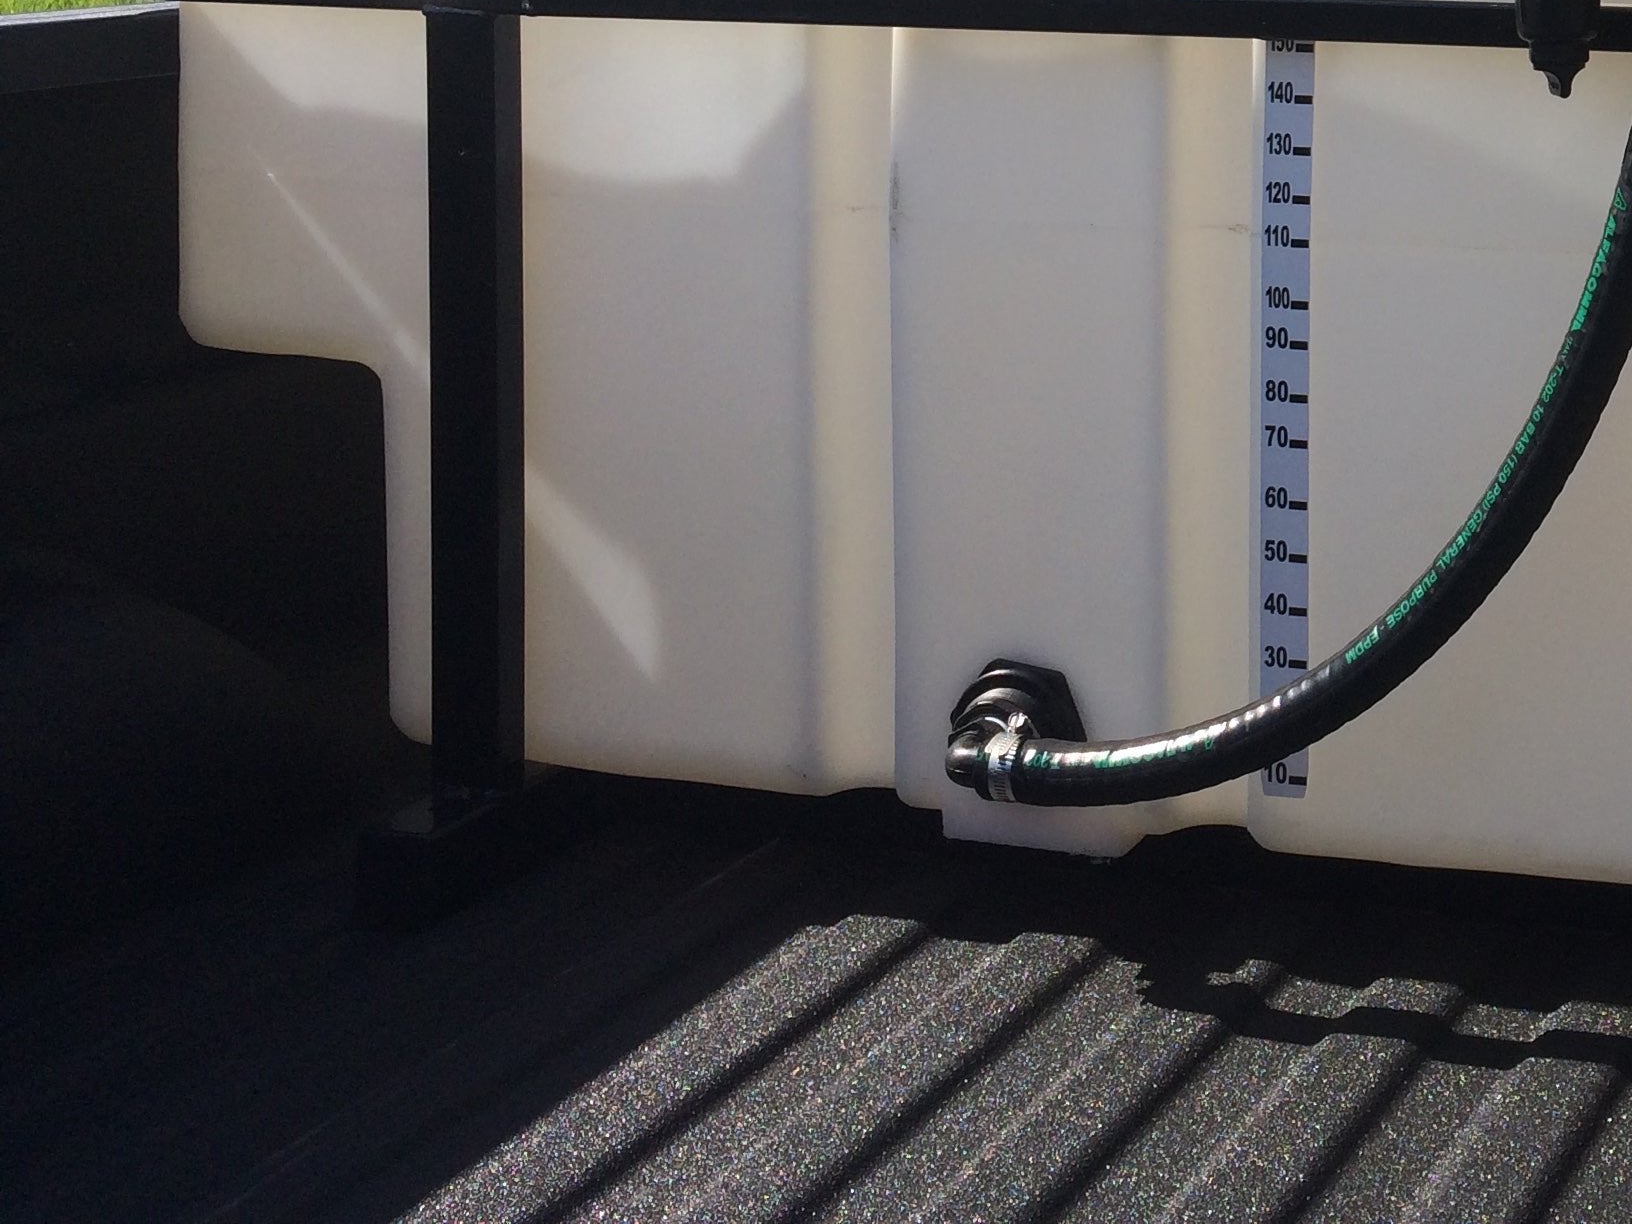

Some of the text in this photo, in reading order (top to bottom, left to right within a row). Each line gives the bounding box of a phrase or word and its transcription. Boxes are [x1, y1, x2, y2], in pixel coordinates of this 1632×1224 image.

[1268, 81, 1293, 104] 140
[1266, 133, 1291, 155] 130
[1265, 181, 1290, 204] 120
[1264, 225, 1290, 247] 110
[1571, 213, 1617, 332] ALFAGOMMA
[1265, 286, 1290, 309] 100
[1265, 326, 1288, 349] 90
[1265, 380, 1289, 402] 80
[1541, 364, 1564, 403] T-202
[1532, 404, 1544, 422] 10
[1264, 425, 1288, 447] 70
[1515, 422, 1535, 454] BAR
[1499, 453, 1518, 484] (150
[1264, 487, 1288, 509] 60
[1264, 540, 1288, 562] 50
[1435, 510, 1483, 570] GENERAL
[1264, 593, 1287, 615] 40
[1386, 569, 1438, 629] PURPOSE
[1345, 624, 1381, 664] EPDM
[1264, 646, 1287, 668] 30
[1264, 762, 1287, 784] 10
